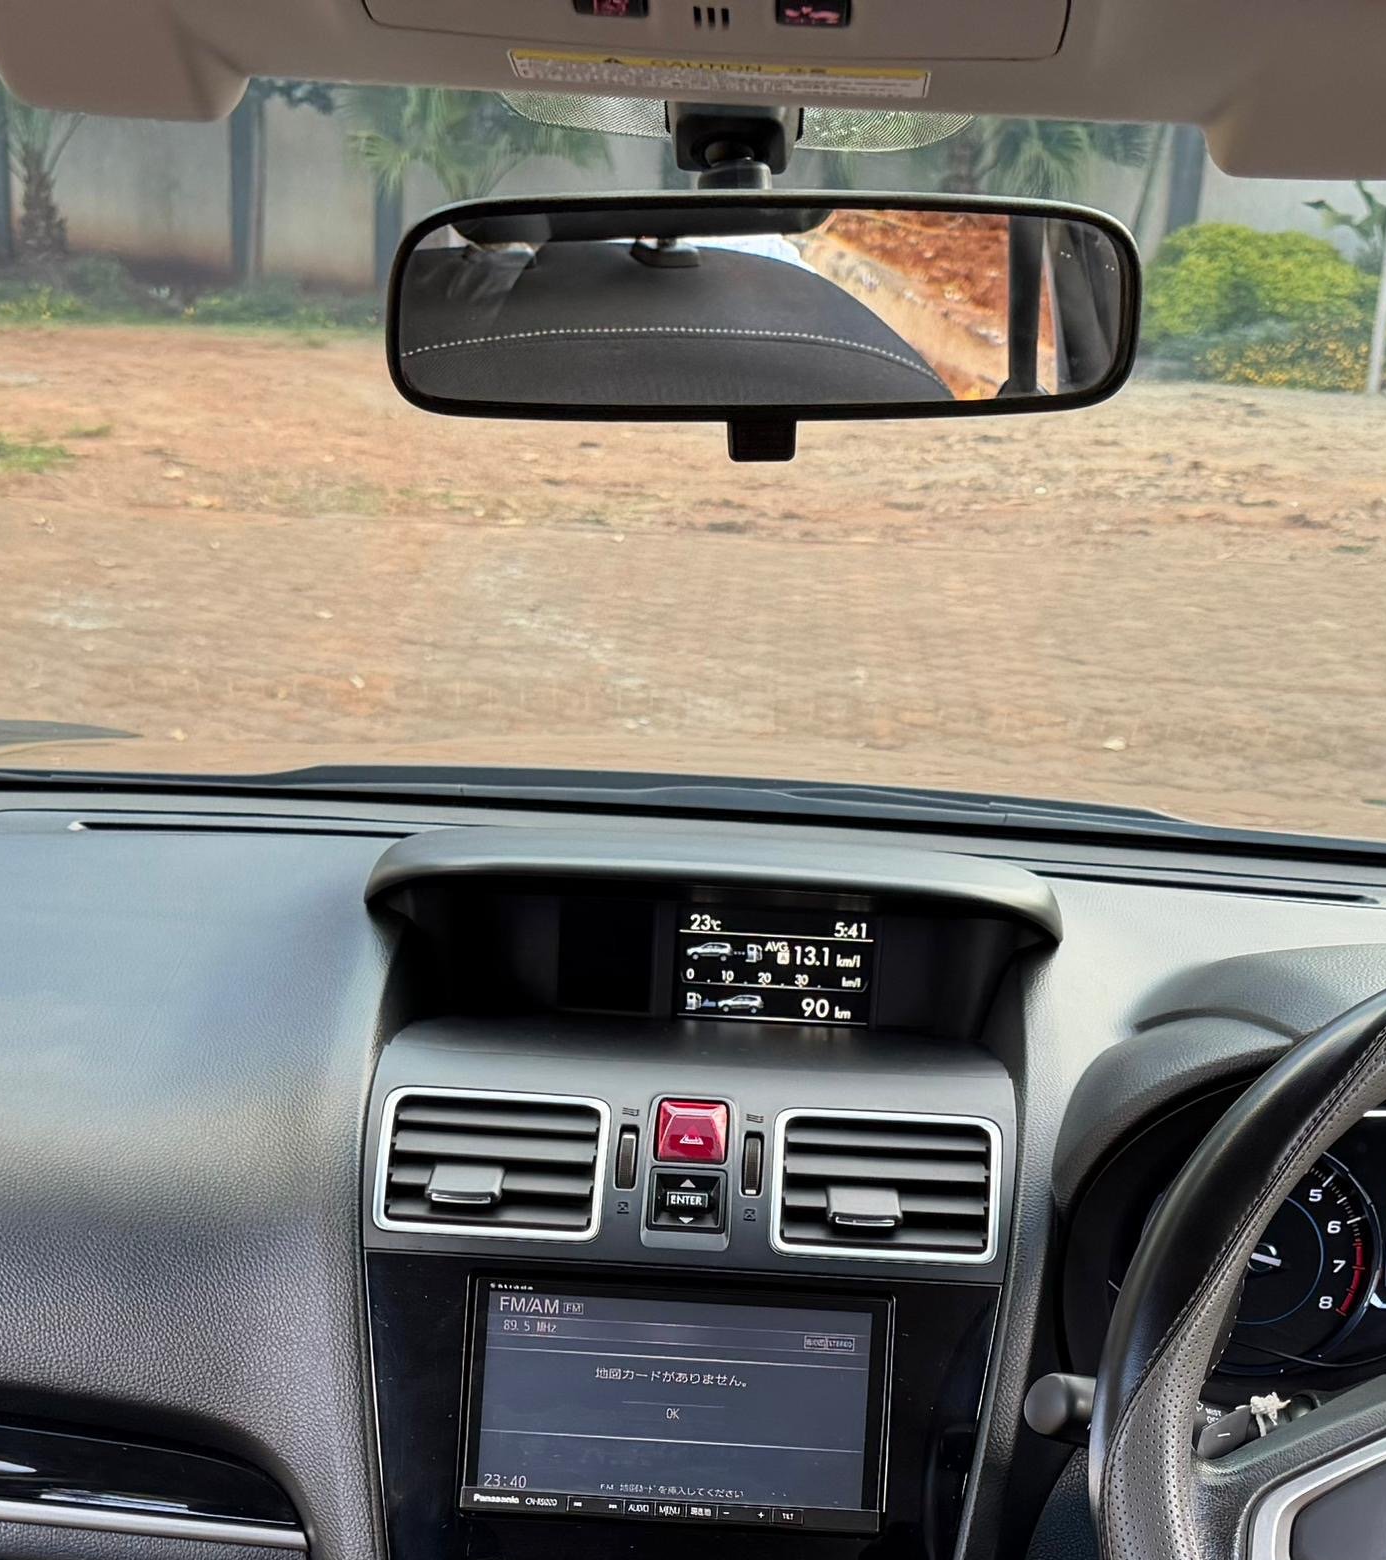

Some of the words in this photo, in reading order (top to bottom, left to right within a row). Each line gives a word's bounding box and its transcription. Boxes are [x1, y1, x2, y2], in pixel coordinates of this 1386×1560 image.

[834, 922, 867, 938] 5:41
[764, 941, 789, 952] AVG
[795, 946, 829, 966] 13.1
[836, 954, 861, 968] km/l
[686, 968, 695, 980] 0
[721, 970, 734, 982] 10
[757, 972, 772, 984] 20
[794, 974, 809, 986] 30
[801, 998, 830, 1018] 90
[835, 1006, 851, 1019] km
[670, 1195, 702, 1206] ENTER
[1309, 1190, 1322, 1202] 5
[1327, 1222, 1341, 1234] 6
[1333, 1260, 1346, 1273] 7
[500, 1296, 559, 1314] FM/AM
[566, 1303, 581, 1313] FM
[1319, 1296, 1332, 1308] 8
[536, 1321, 557, 1333] MHz
[666, 1407, 680, 1420] OK
[484, 1473, 527, 1489] 23:40
